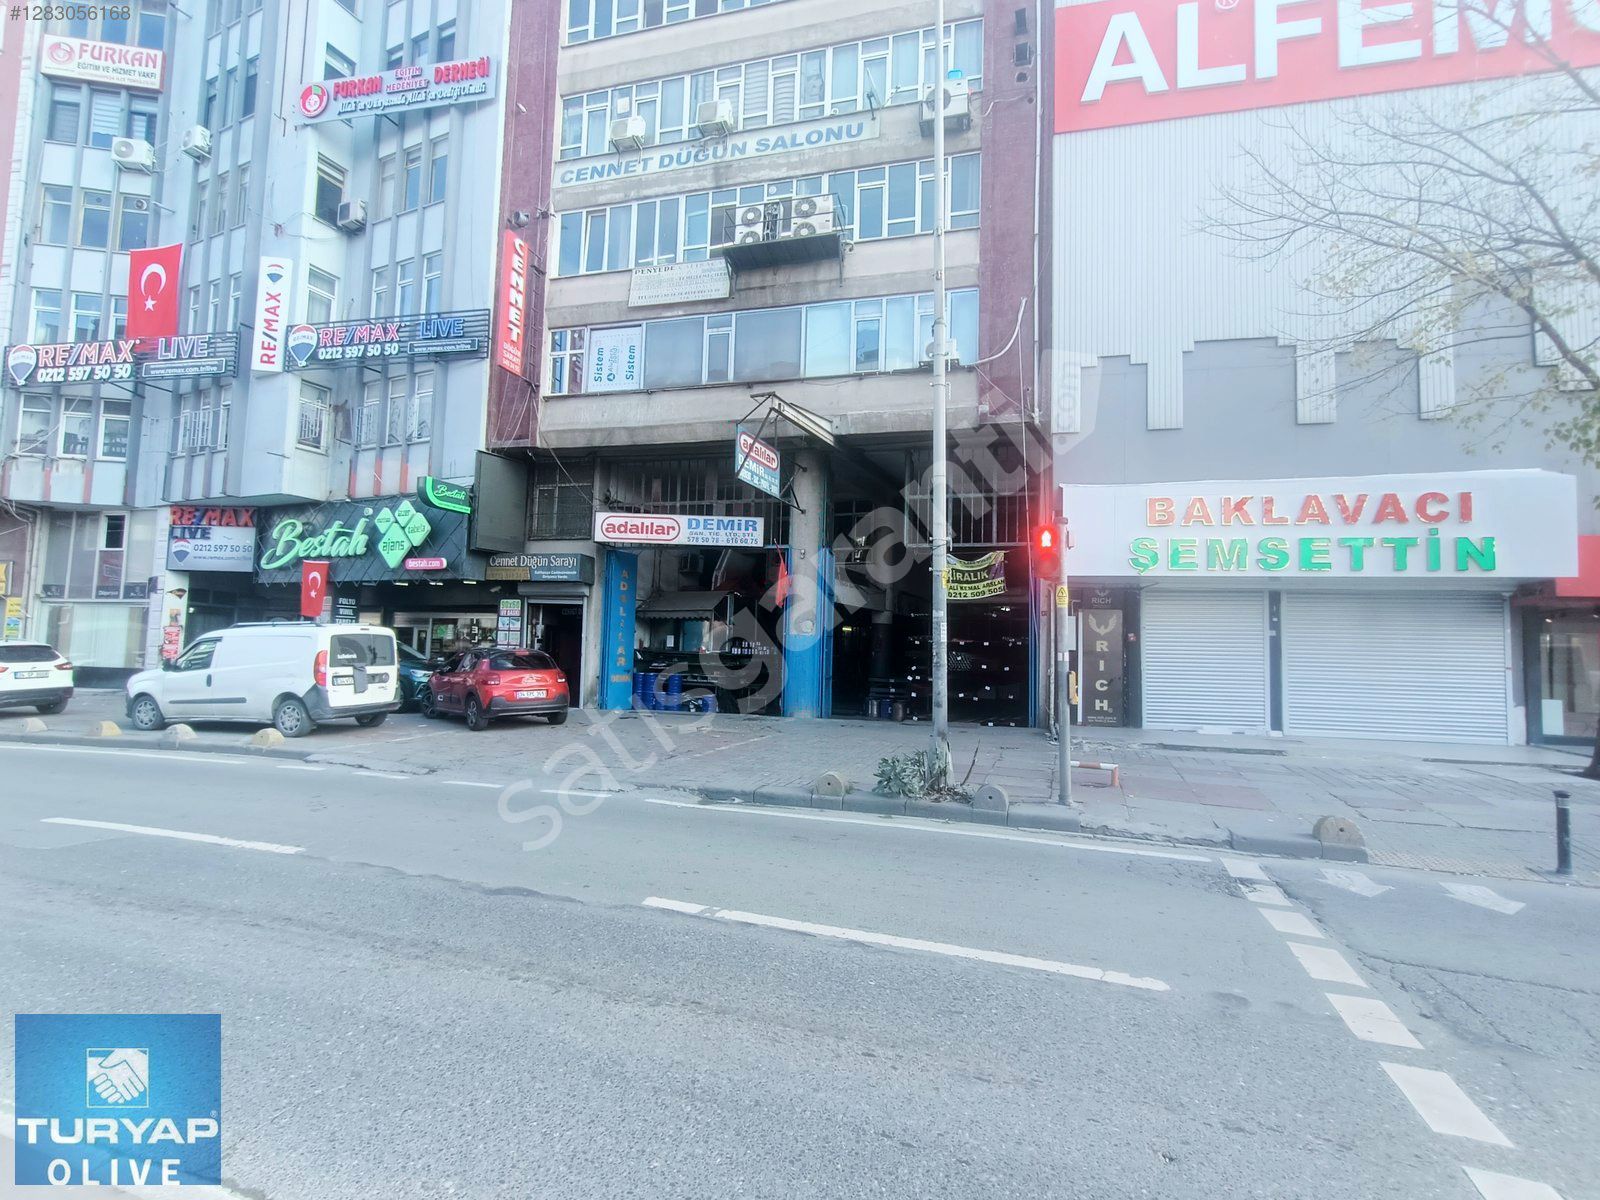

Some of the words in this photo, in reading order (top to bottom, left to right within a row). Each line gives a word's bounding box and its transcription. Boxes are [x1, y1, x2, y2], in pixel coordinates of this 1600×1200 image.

[79, 42, 158, 69] FURKAN
[1080, 0, 1600, 104] ALFEM
[333, 76, 383, 99] FURKAN
[560, 156, 654, 185] CENNET
[755, 122, 864, 153] SALONU
[508, 238, 524, 343] CENNET
[260, 291, 282, 365] RE/MAX
[319, 323, 400, 347] RE/MAX
[420, 317, 465, 340] LIVE
[38, 341, 137, 367] RE/MAX
[158, 335, 211, 360] LIVE
[318, 346, 342, 359] 0212
[344, 345, 364, 358] 597
[367, 344, 381, 357] 50
[384, 342, 399, 356] 50
[594, 347, 604, 382] Sistem
[626, 345, 636, 380] Sistem
[37, 367, 64, 382] 0212
[68, 366, 88, 381] 597
[93, 365, 109, 380] 50
[113, 364, 131, 379] 50
[1145, 492, 1473, 527] BAKLAVACI
[171, 527, 212, 539] LIVE
[604, 521, 676, 536] adalılar
[193, 544, 212, 552] 0212
[213, 544, 228, 552] 597
[229, 545, 241, 553] 50
[242, 545, 253, 553] 50
[260, 518, 369, 570] Bestah
[382, 538, 405, 554] ajans
[490, 555, 518, 567] Cennet
[520, 555, 548, 569] Düğün
[550, 555, 577, 568] Sarayı
[970, 590, 986, 598] 509
[1094, 640, 1109, 711] RICH
